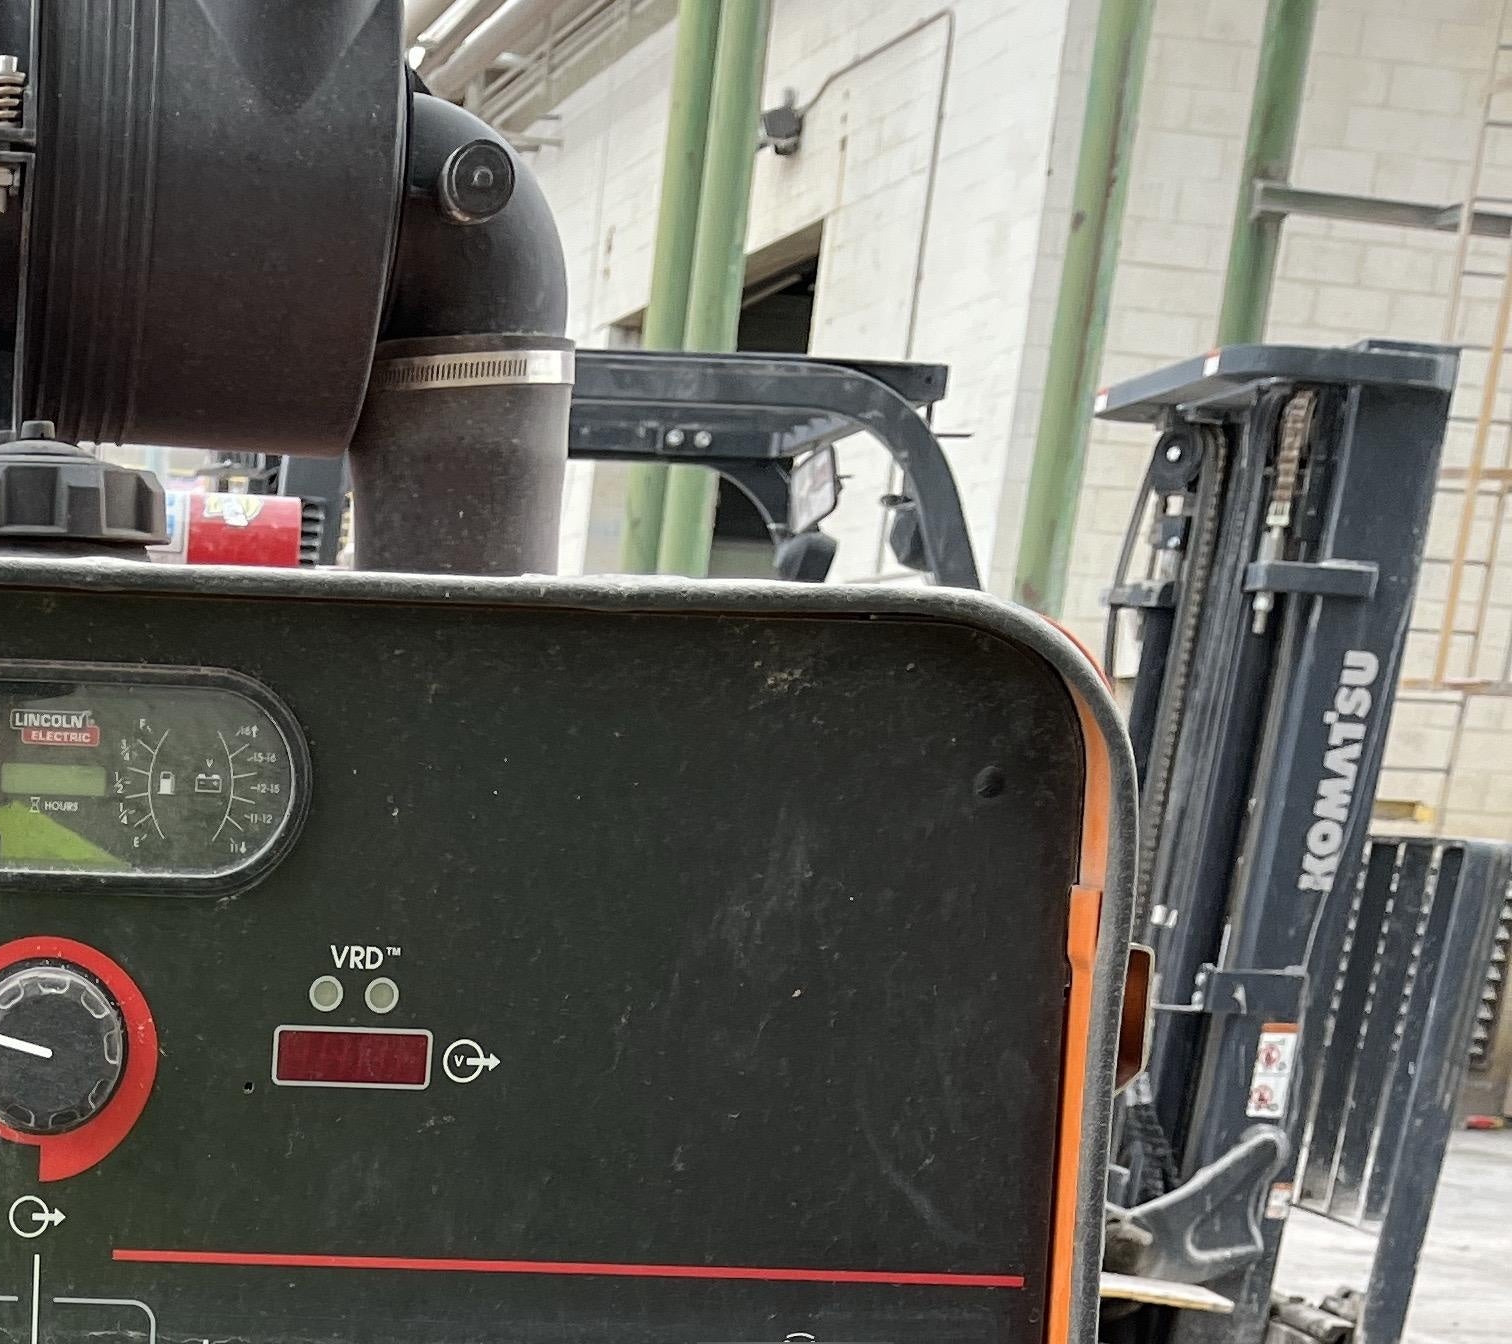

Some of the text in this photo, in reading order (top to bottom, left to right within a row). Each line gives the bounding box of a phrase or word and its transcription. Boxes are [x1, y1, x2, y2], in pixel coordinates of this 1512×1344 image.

[15, 713, 83, 728] LINCOLN
[31, 730, 91, 742] ELECTRIC
[1299, 649, 1379, 892] KOMATSU
[44, 801, 79, 811] HOURS
